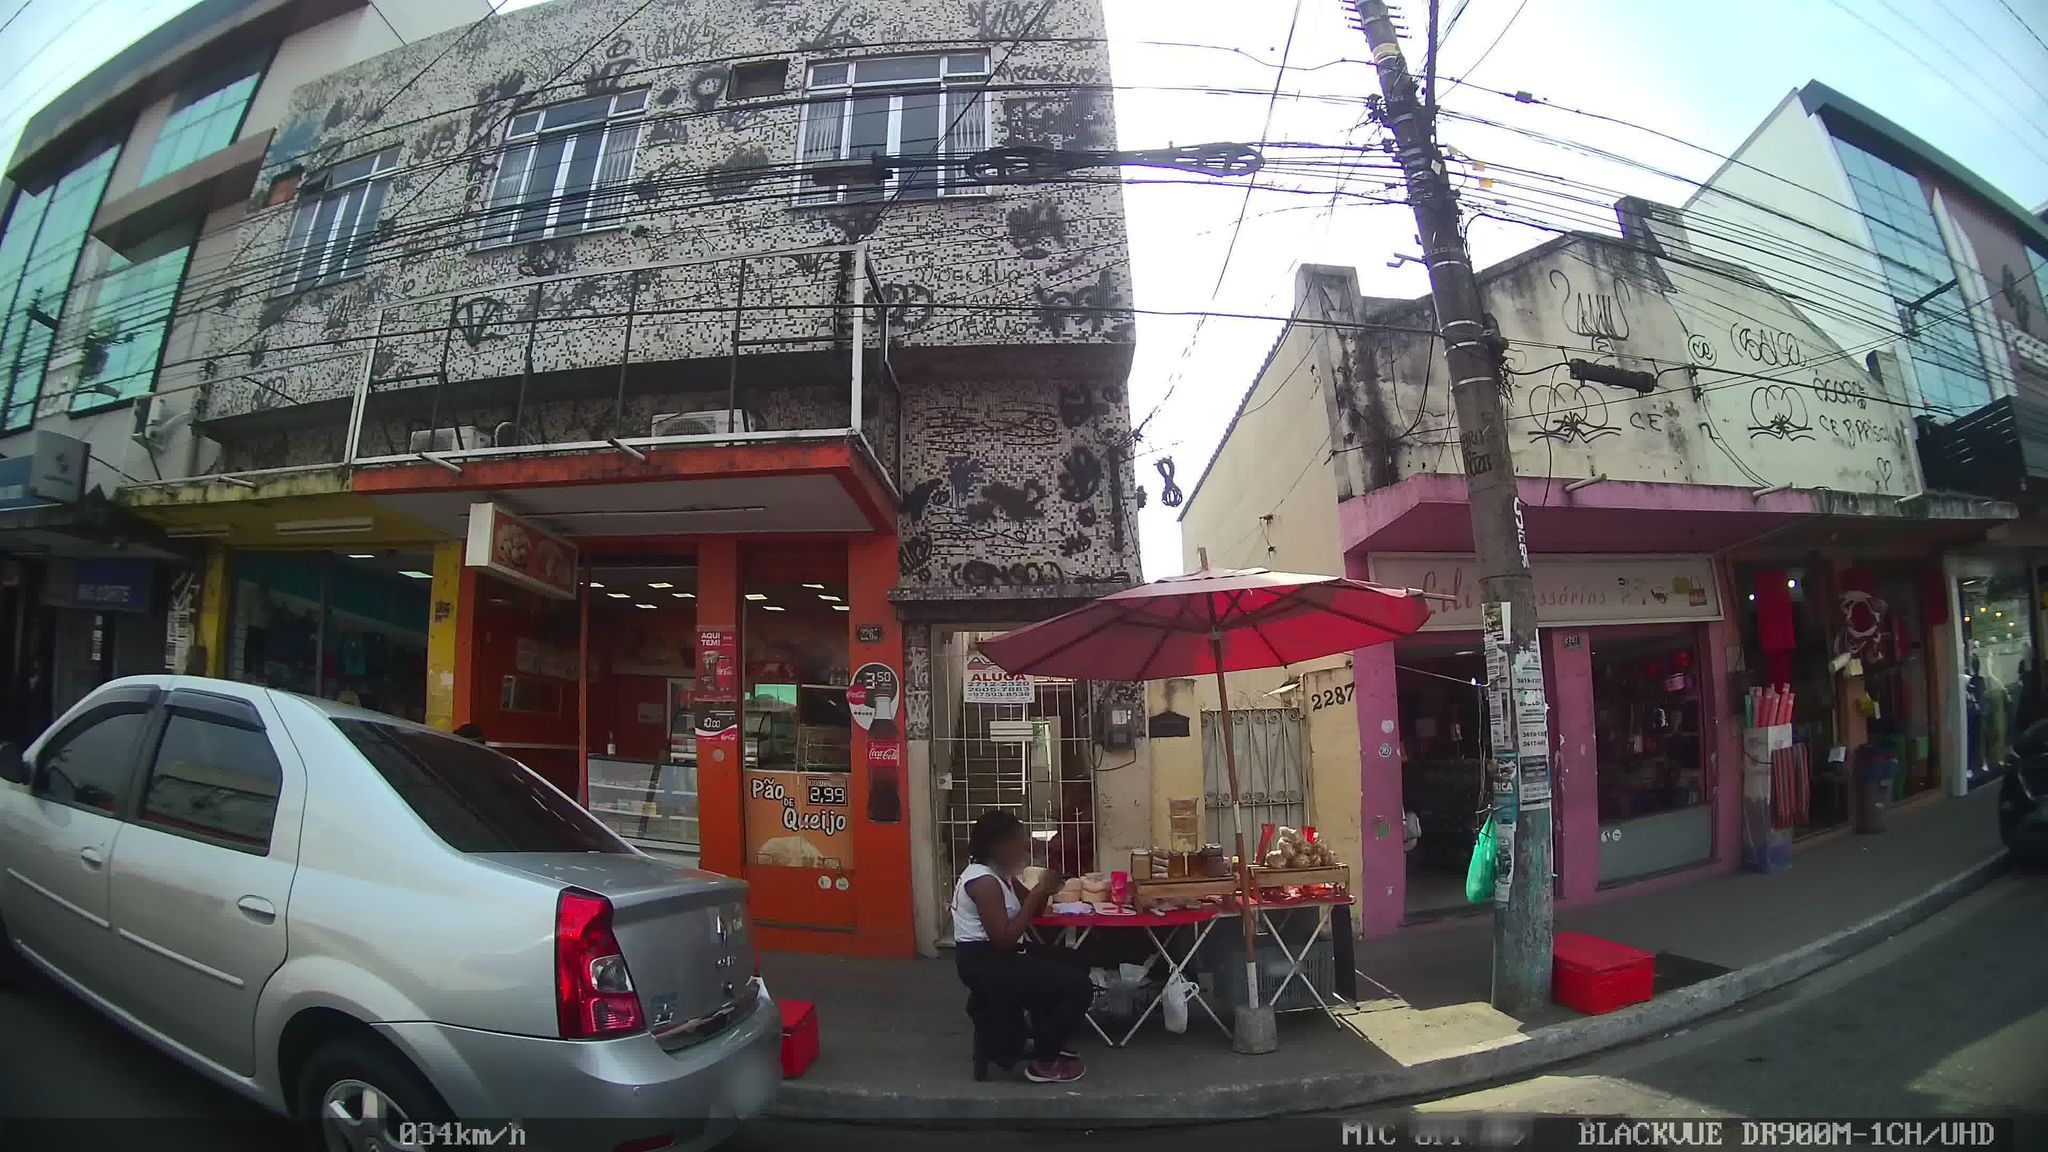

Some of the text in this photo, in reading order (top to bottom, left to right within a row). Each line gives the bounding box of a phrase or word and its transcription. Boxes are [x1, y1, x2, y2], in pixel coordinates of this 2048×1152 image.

[1311, 681, 1355, 712] 2287
[752, 778, 784, 800] Pão
[810, 786, 845, 804] 2,99
[783, 797, 795, 806] DE
[782, 807, 846, 836] Queijo
